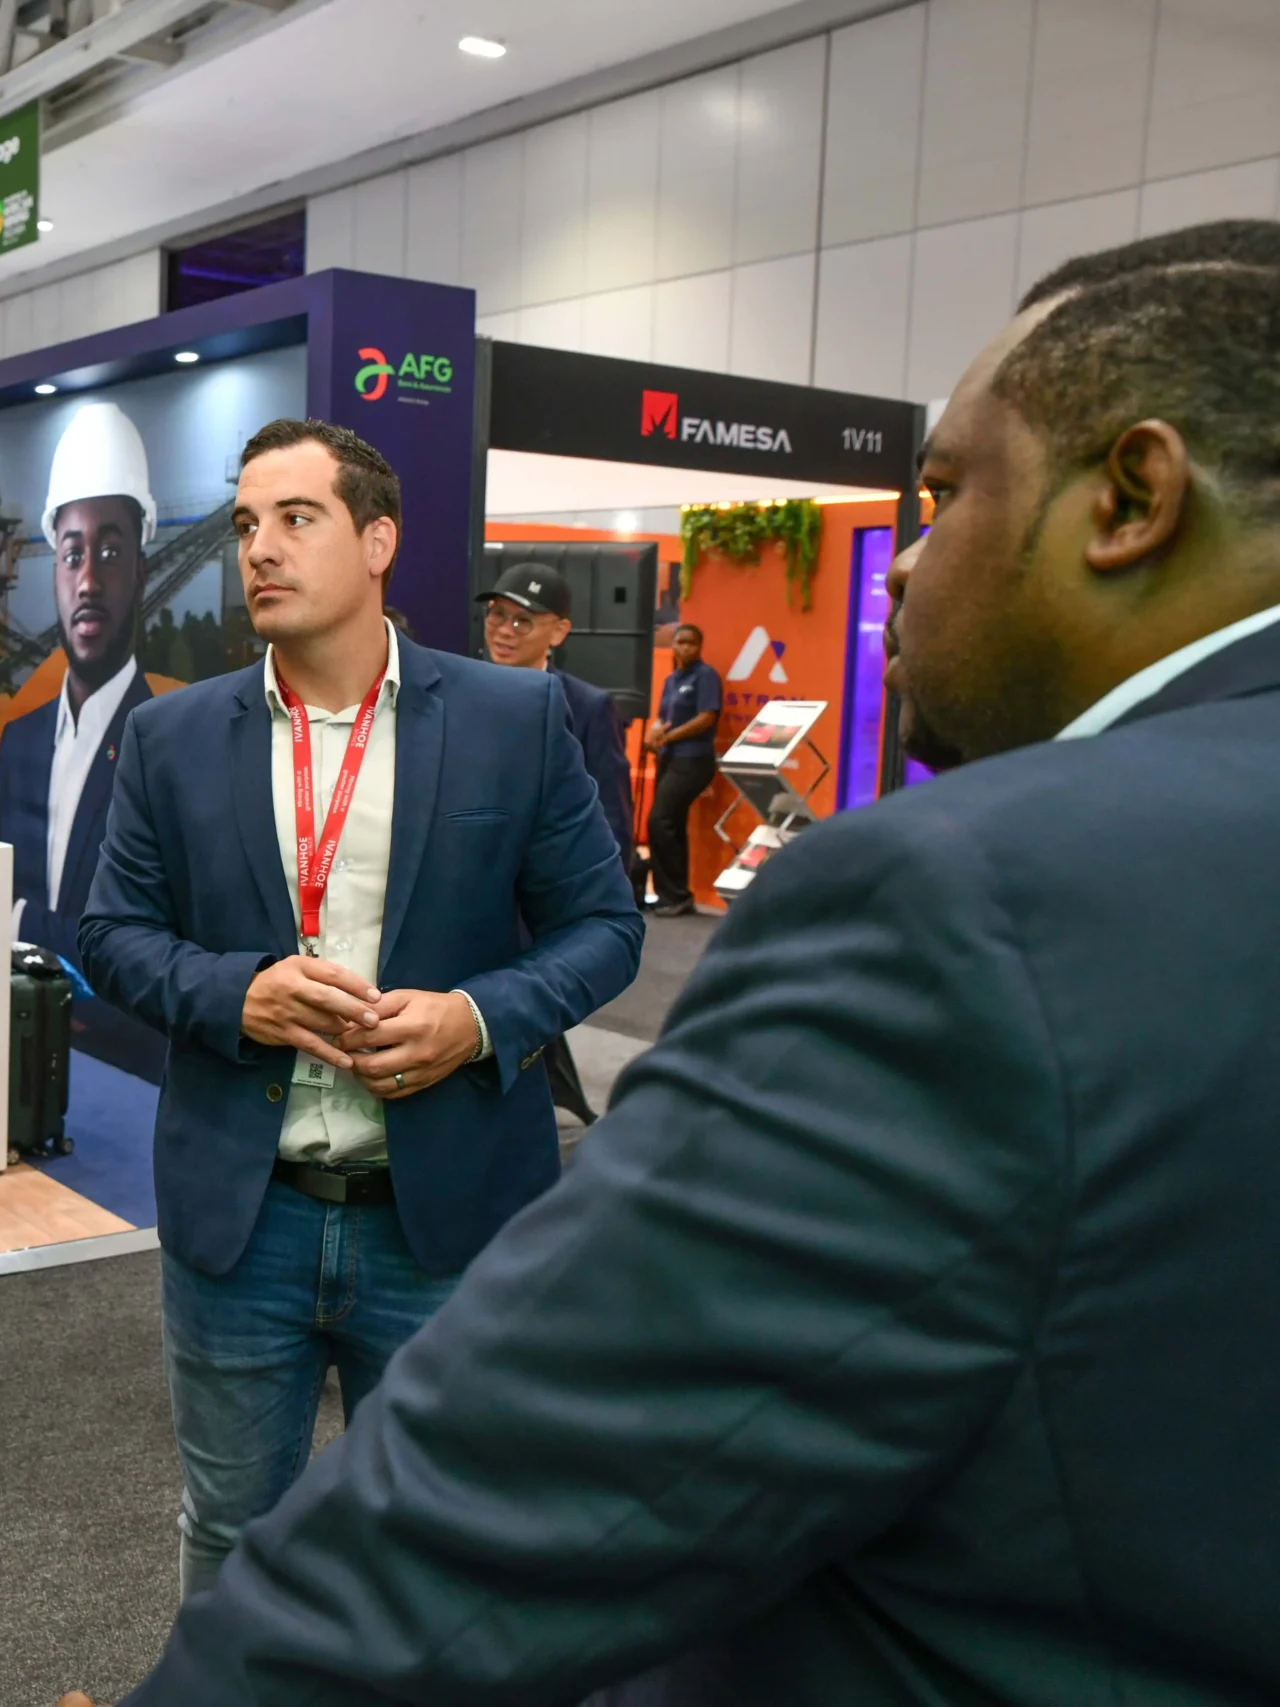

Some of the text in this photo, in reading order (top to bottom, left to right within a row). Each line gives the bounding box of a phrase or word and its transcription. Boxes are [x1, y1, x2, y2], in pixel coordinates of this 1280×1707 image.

[398, 352, 453, 383] AFG
[681, 417, 792, 454] FAMESA
[842, 428, 883, 453] 1V11
[355, 706, 375, 748] IVANHOE
[298, 837, 308, 887] IVANHOE
[315, 840, 336, 888] IVANHOE
